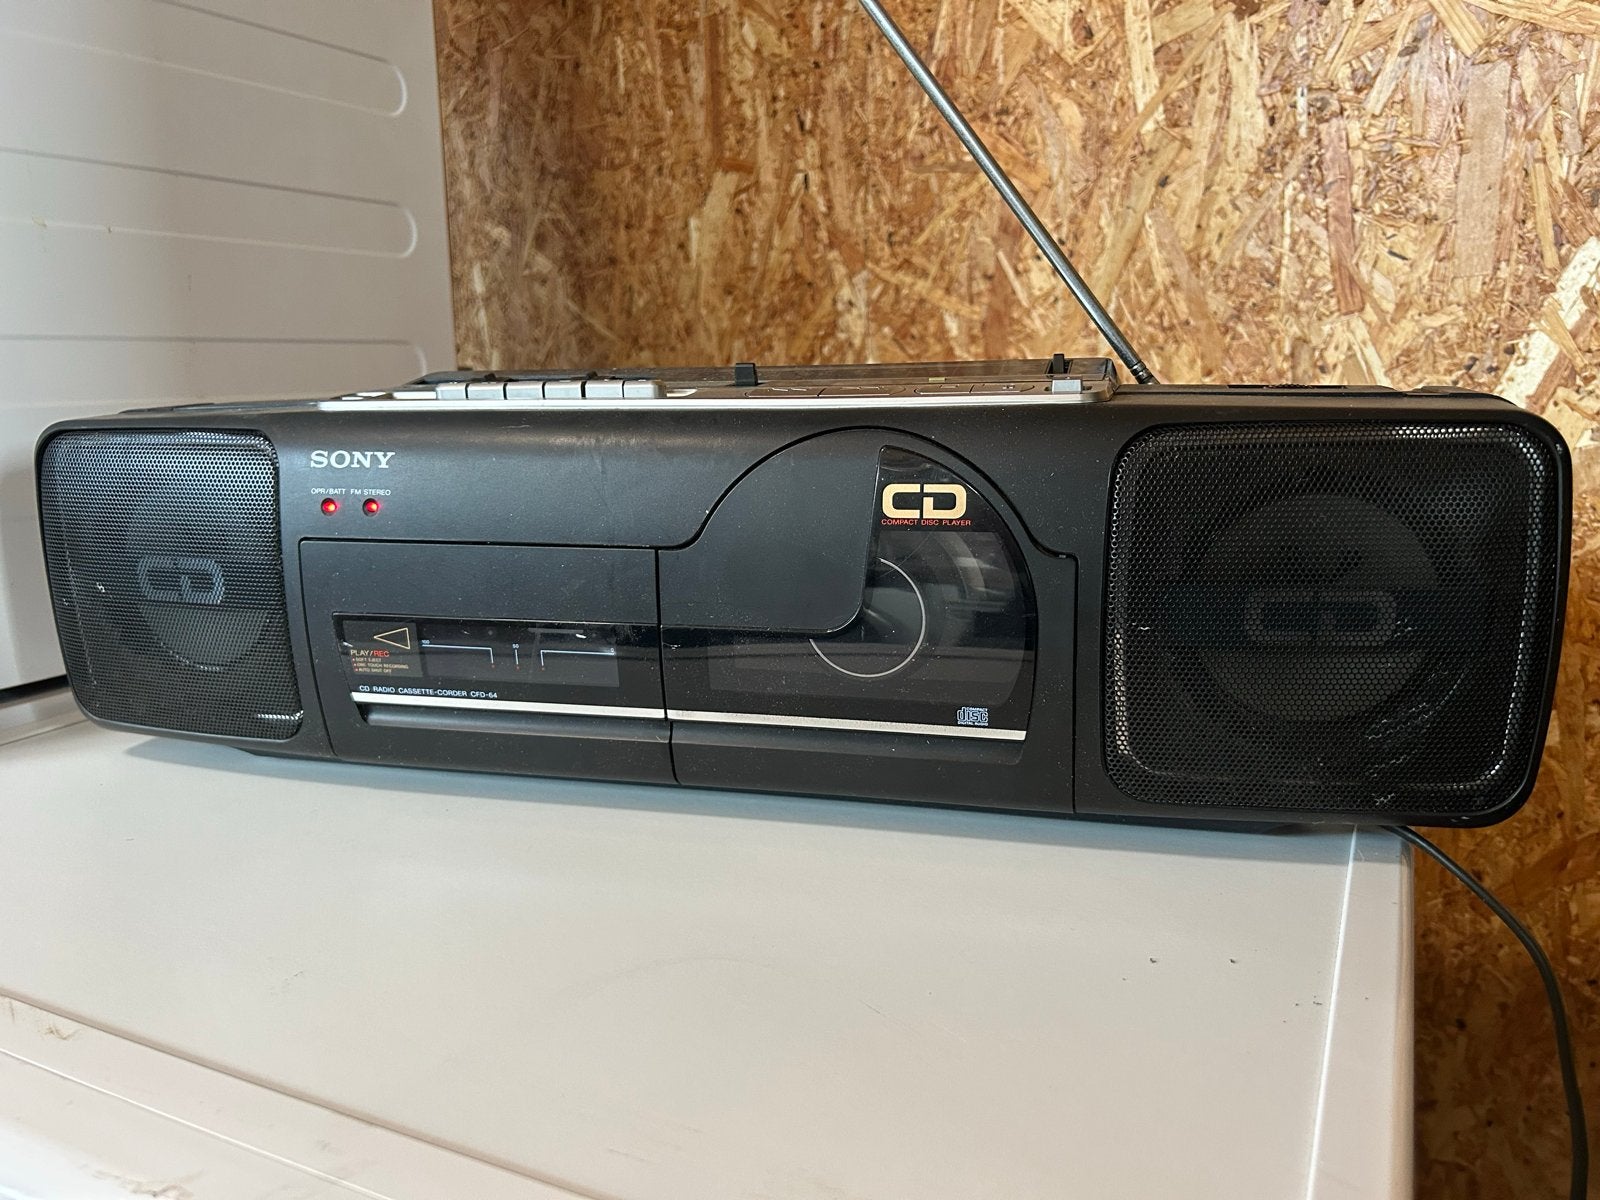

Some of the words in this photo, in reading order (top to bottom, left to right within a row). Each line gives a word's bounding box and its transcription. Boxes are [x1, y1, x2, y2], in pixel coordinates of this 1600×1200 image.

[310, 450, 395, 468] SONY
[363, 488, 391, 496] STEREO
[882, 483, 967, 518] CD
[350, 649, 390, 657] PLAY/REC
[398, 687, 467, 697] CASSETTE-CORDER
[470, 690, 498, 698] CFD-64
